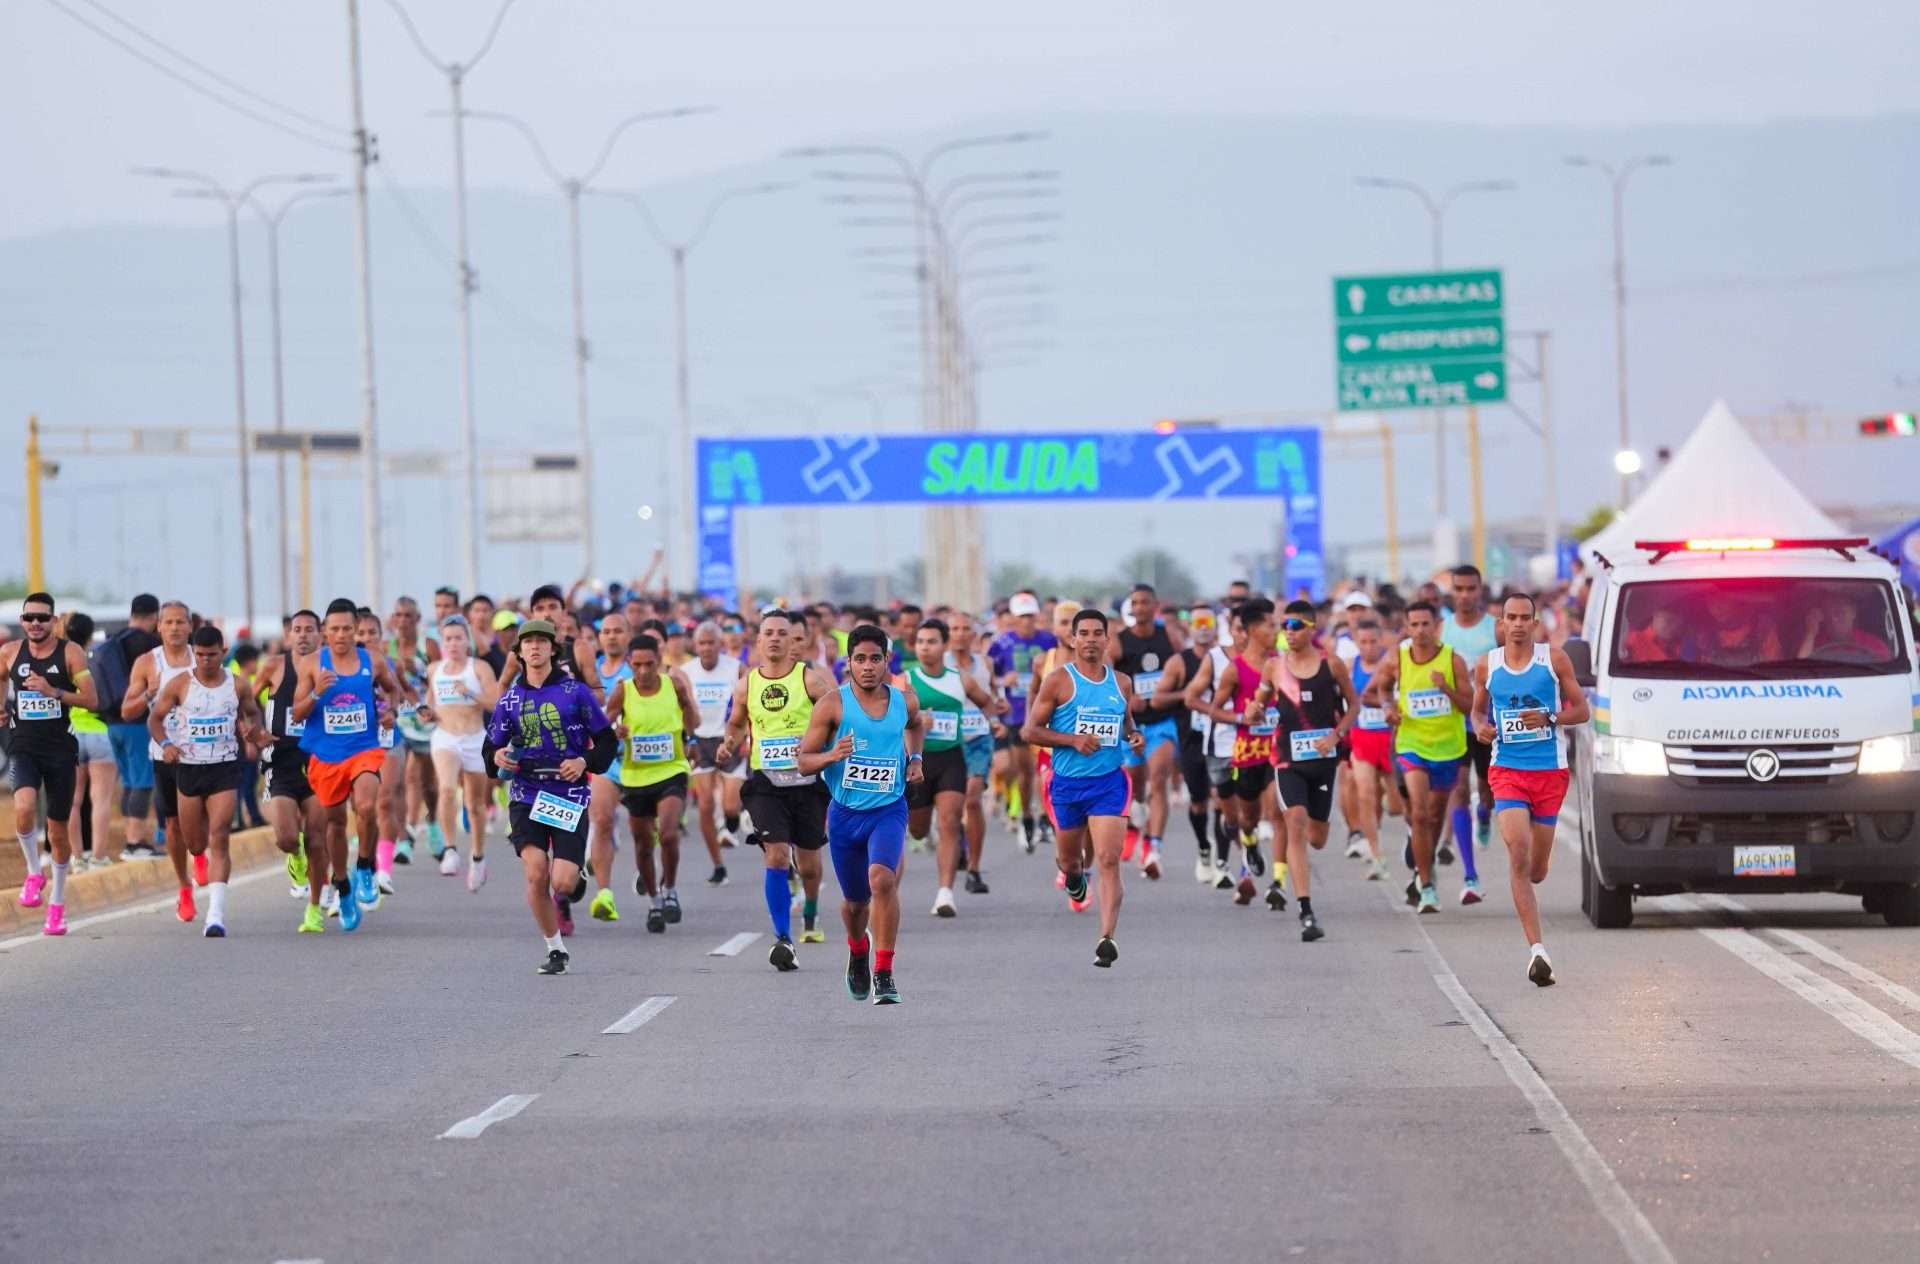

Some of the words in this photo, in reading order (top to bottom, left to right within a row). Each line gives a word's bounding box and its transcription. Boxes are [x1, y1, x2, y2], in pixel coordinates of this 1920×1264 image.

[1387, 280, 1497, 306] CARACAS
[1376, 326, 1499, 351] AEROPUERTO
[1342, 364, 1435, 387] CAICARA
[1343, 385, 1408, 406] PLAYA
[924, 442, 1099, 494] SALIDA
[21, 699, 56, 711] 2155
[1411, 696, 1443, 709] 2117
[328, 713, 362, 725] 2246
[190, 725, 224, 736] 2181
[1079, 723, 1113, 736] 2144
[1750, 728, 1840, 741] CIENFUEGOS
[635, 742, 669, 754] 2095
[847, 765, 891, 782] 2122
[536, 801, 575, 822] 2249
